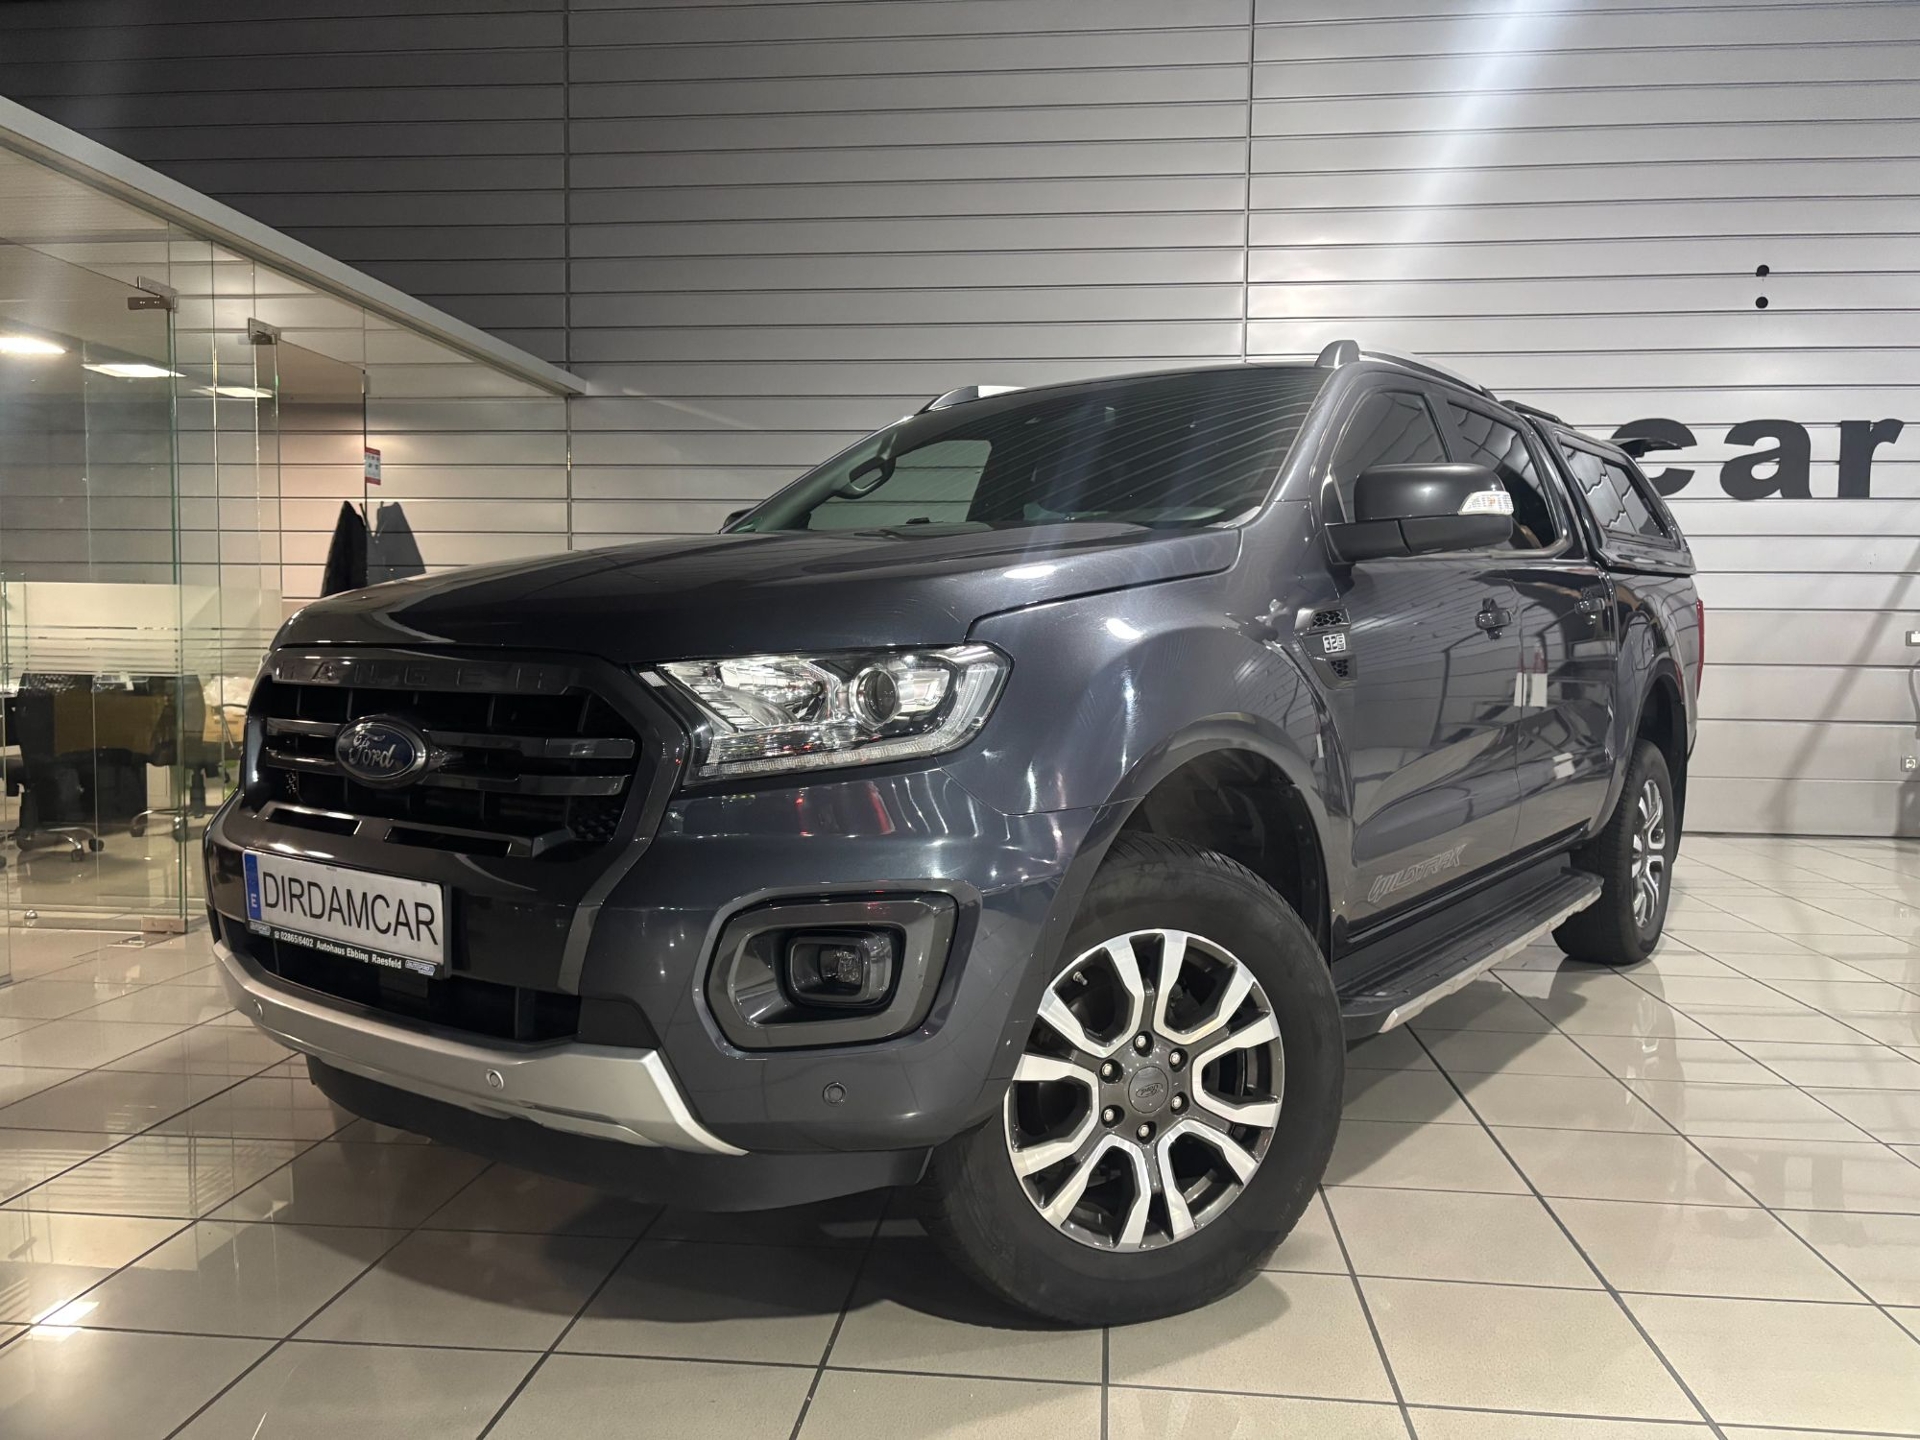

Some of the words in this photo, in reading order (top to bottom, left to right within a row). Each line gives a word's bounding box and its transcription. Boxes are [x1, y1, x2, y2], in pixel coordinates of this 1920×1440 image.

[348, 731, 396, 768] Ford
[250, 893, 258, 908] E
[262, 871, 439, 946] DIRDAMCAR
[316, 940, 345, 955] Autohaus
[346, 947, 369, 963] Ebbing
[371, 953, 402, 969] Raesfeld
